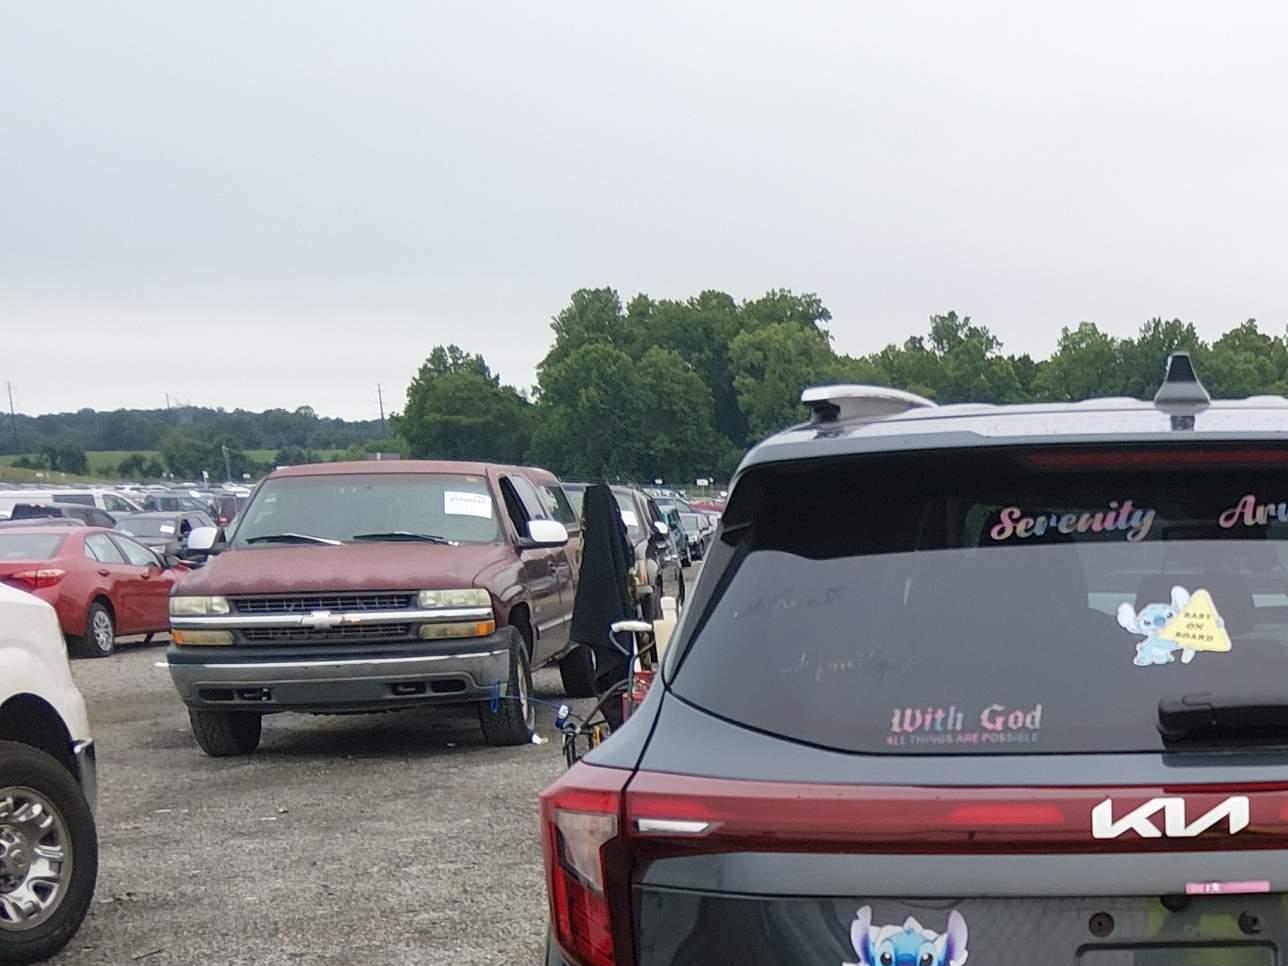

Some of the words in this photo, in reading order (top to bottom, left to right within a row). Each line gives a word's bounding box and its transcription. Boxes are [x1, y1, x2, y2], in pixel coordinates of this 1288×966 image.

[990, 500, 1156, 542] Serenity
[1175, 631, 1214, 641] BOARD
[1186, 622, 1204, 631] ON
[891, 705, 964, 732] With
[980, 704, 1042, 731] God
[955, 732, 979, 744] ARE
[981, 731, 1040, 744] POSSIBLE
[1091, 796, 1250, 839] KIA
